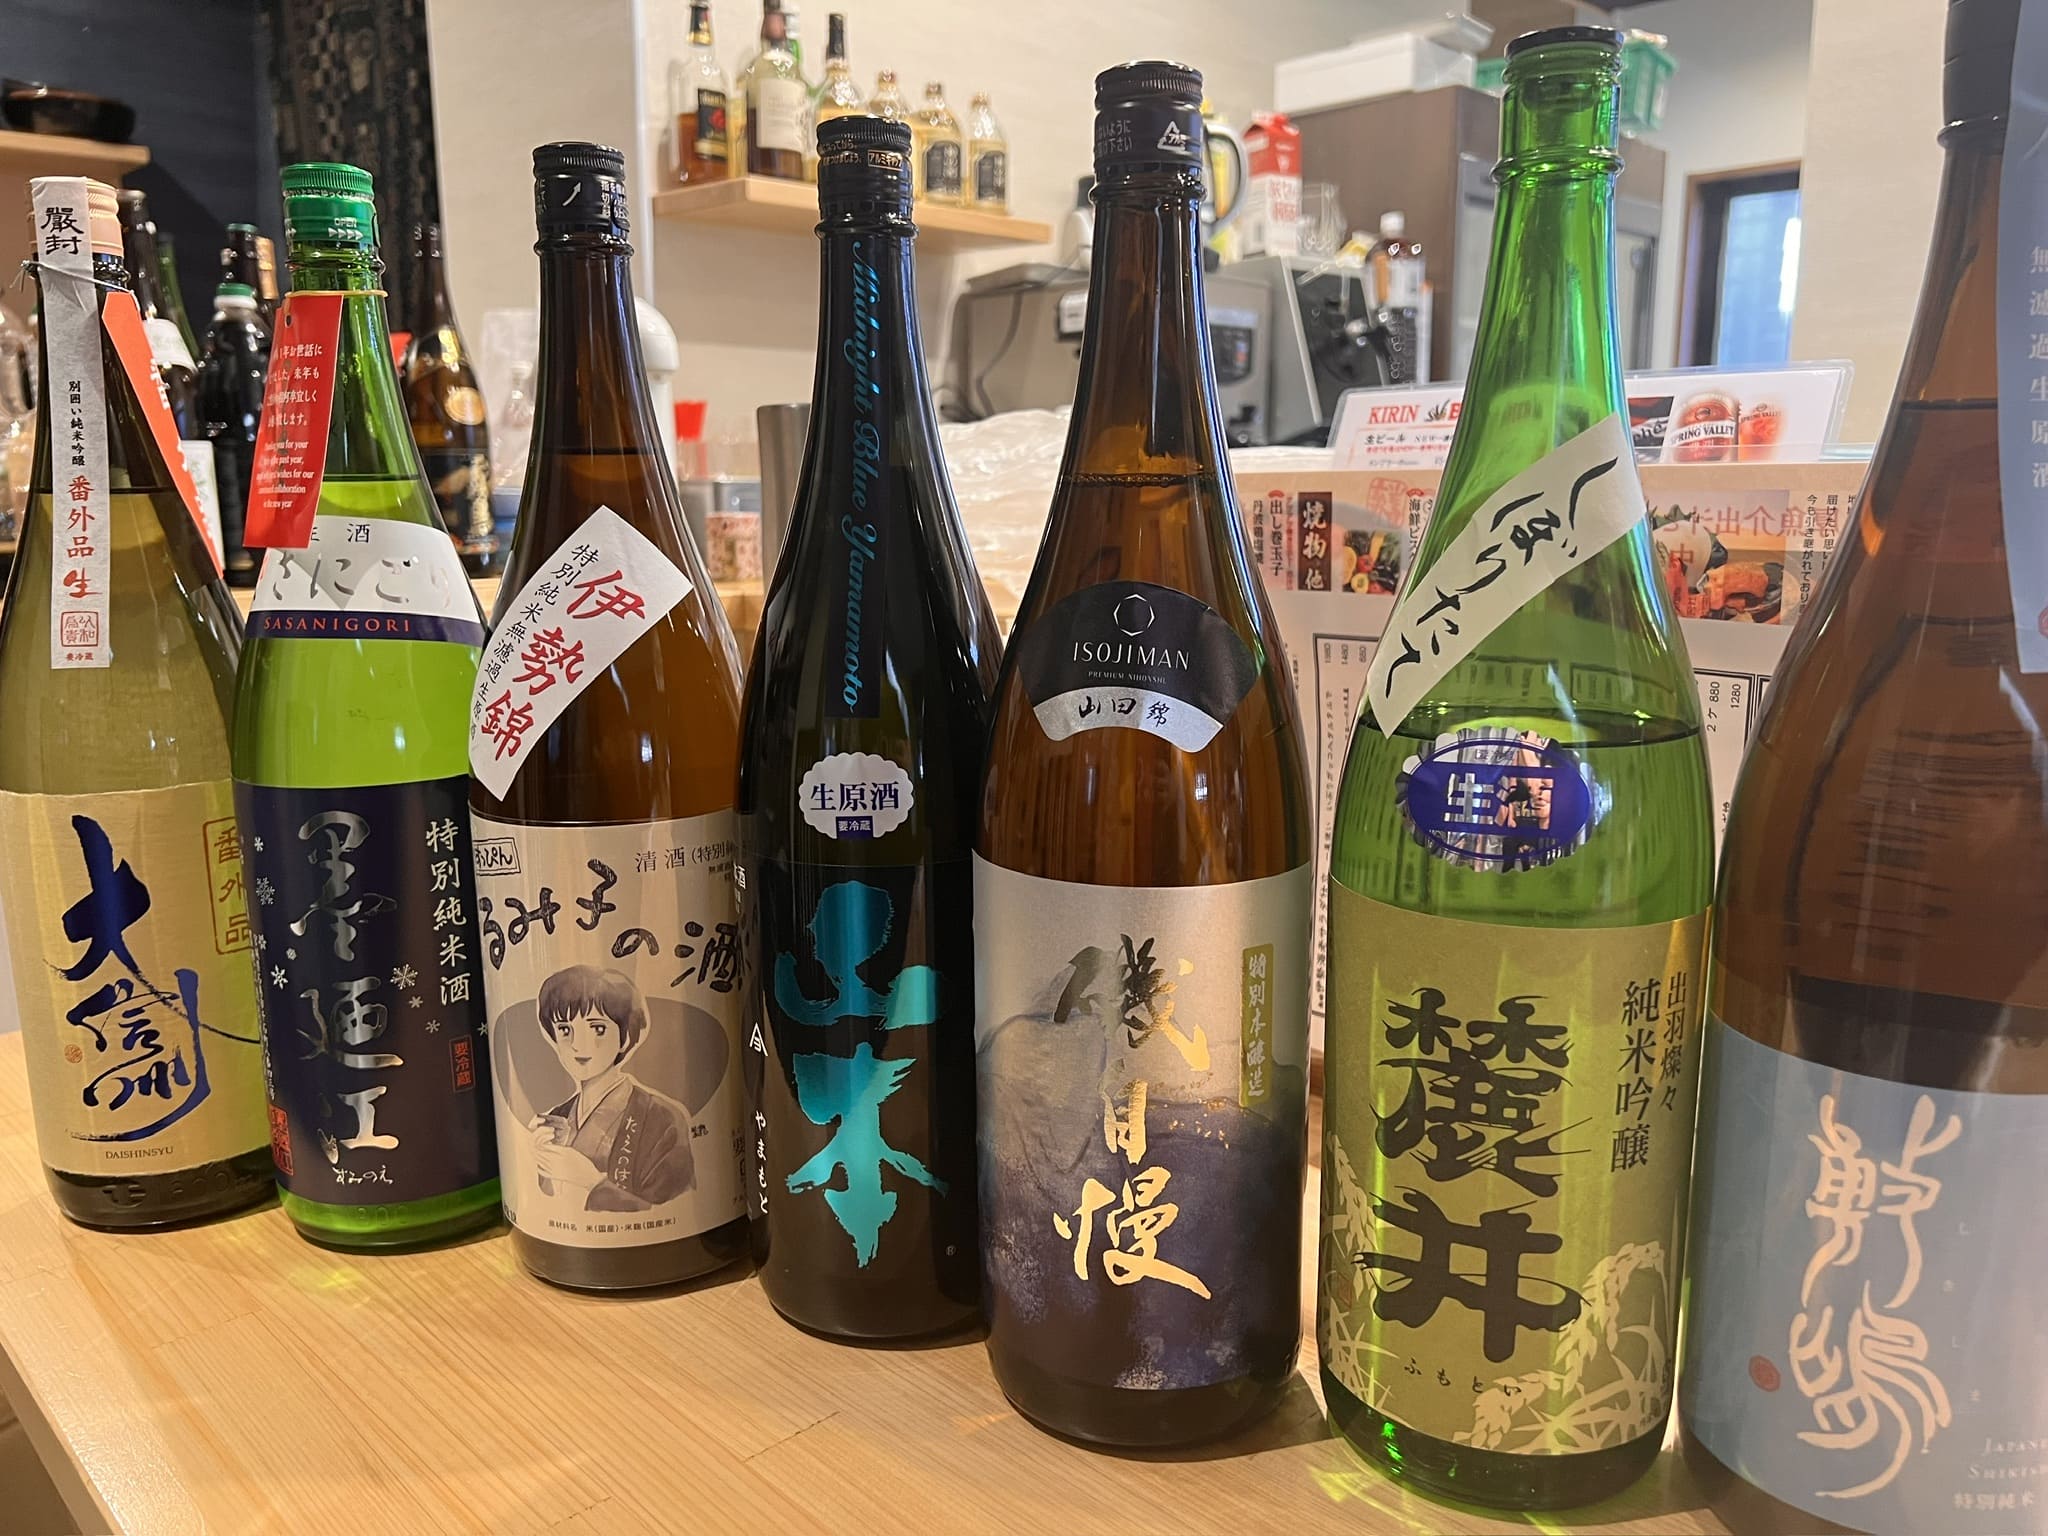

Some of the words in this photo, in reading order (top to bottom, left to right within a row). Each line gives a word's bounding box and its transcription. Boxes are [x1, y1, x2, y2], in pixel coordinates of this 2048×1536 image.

[334, 217, 357, 228] OPEN
[843, 241, 881, 416] Midnight
[1368, 404, 1421, 425] KIRIN
[852, 419, 881, 512] Blue
[1385, 456, 1618, 699] しぼりたて
[263, 615, 411, 633] SASANIGORI
[841, 513, 877, 713] Yamamoto
[481, 569, 646, 762] 伊勢錦
[1072, 640, 1190, 672] ISOJIMAN
[1088, 670, 1125, 680] PREMIUM
[1709, 681, 1720, 703] 880
[1730, 683, 1742, 709] 1280
[810, 781, 900, 812] 生原酒
[838, 820, 872, 832] 要冷蔵
[425, 818, 472, 1007] 特別純米酒
[1658, 970, 1688, 1113] 出羽燦々
[774, 880, 948, 1269] 山本
[1611, 978, 1662, 1174] 純米吟醸
[1052, 933, 1213, 1300] 磯自慢
[105, 1146, 174, 1160] DAISHINSYU
[1403, 1356, 1523, 1397] ふもとい
